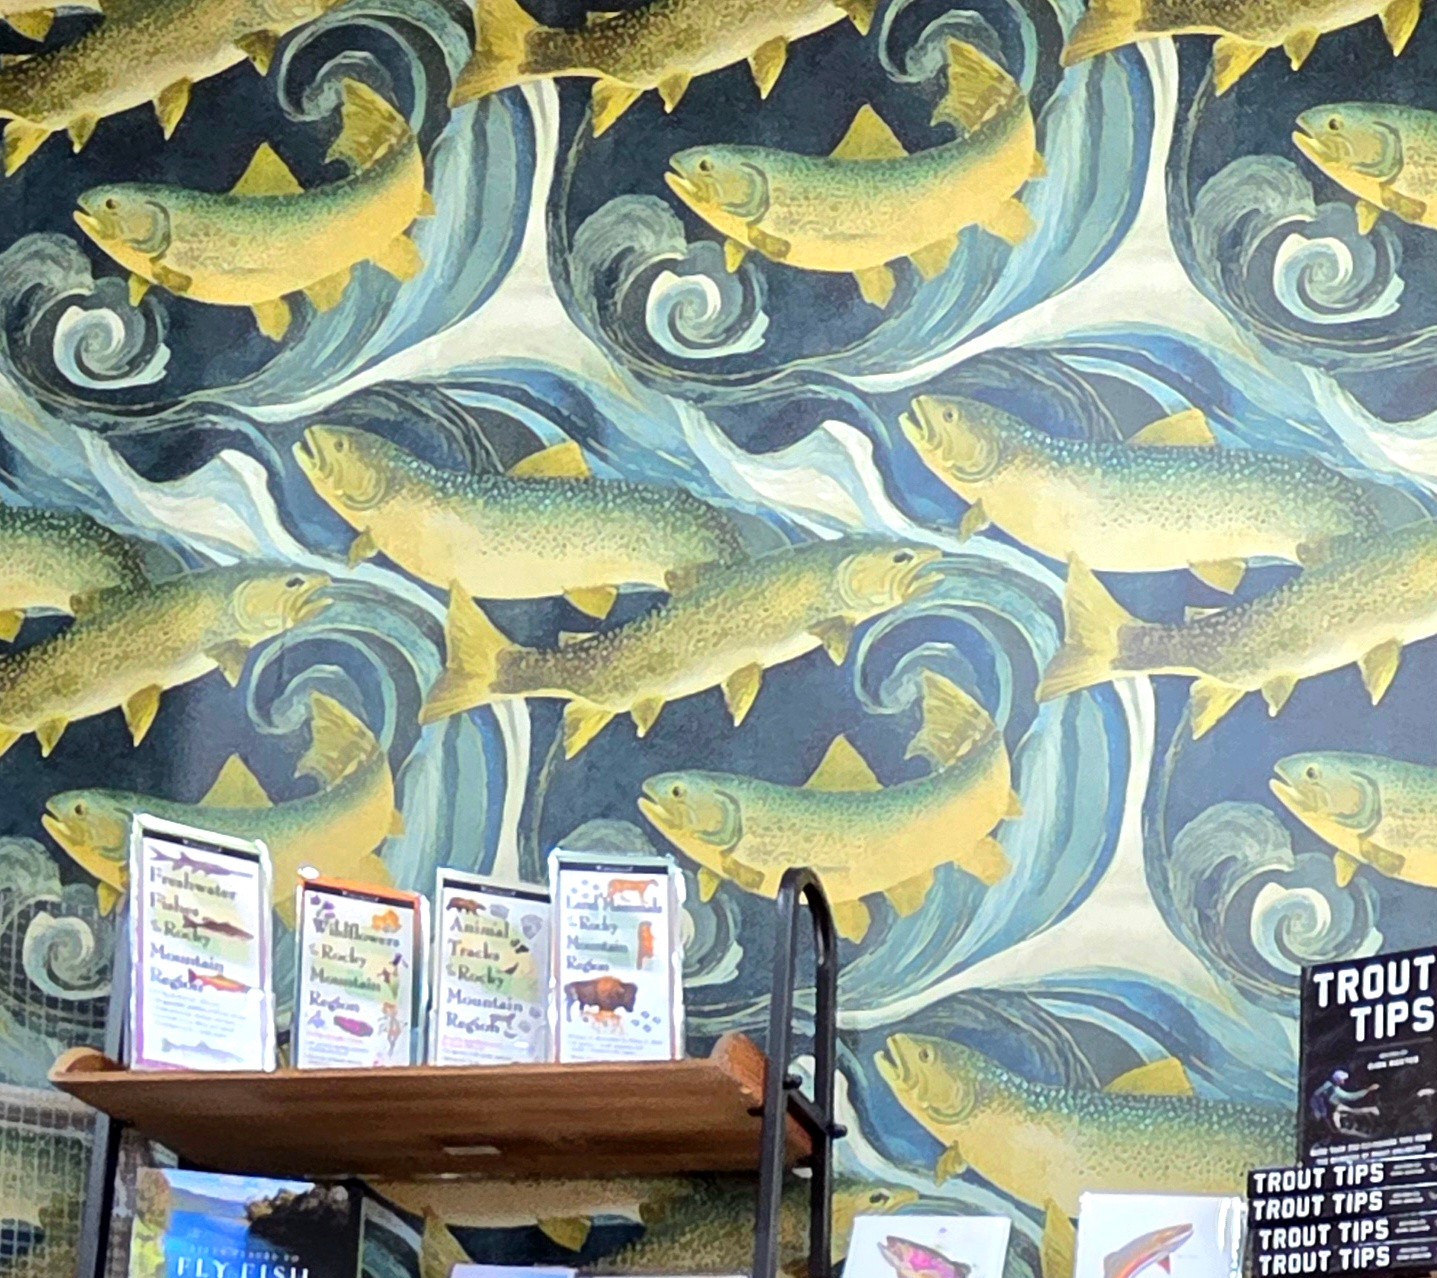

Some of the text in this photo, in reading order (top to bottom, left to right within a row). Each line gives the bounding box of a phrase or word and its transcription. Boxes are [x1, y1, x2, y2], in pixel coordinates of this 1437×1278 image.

[150, 866, 236, 900] Freshwater
[313, 917, 400, 947] Wildflowers
[449, 916, 511, 939] Animal
[150, 943, 224, 972] Mountain
[448, 939, 499, 961] Tracks
[310, 966, 381, 992] Mountain
[458, 965, 504, 988] Rocky
[1313, 955, 1437, 1008] TROUT
[309, 990, 360, 1012] Region
[447, 987, 523, 1012] Mountain
[1350, 996, 1436, 1042] TIPS
[1253, 1162, 1386, 1194] TROUT TIPS
[1253, 1190, 1384, 1222] TROUT TIPS
